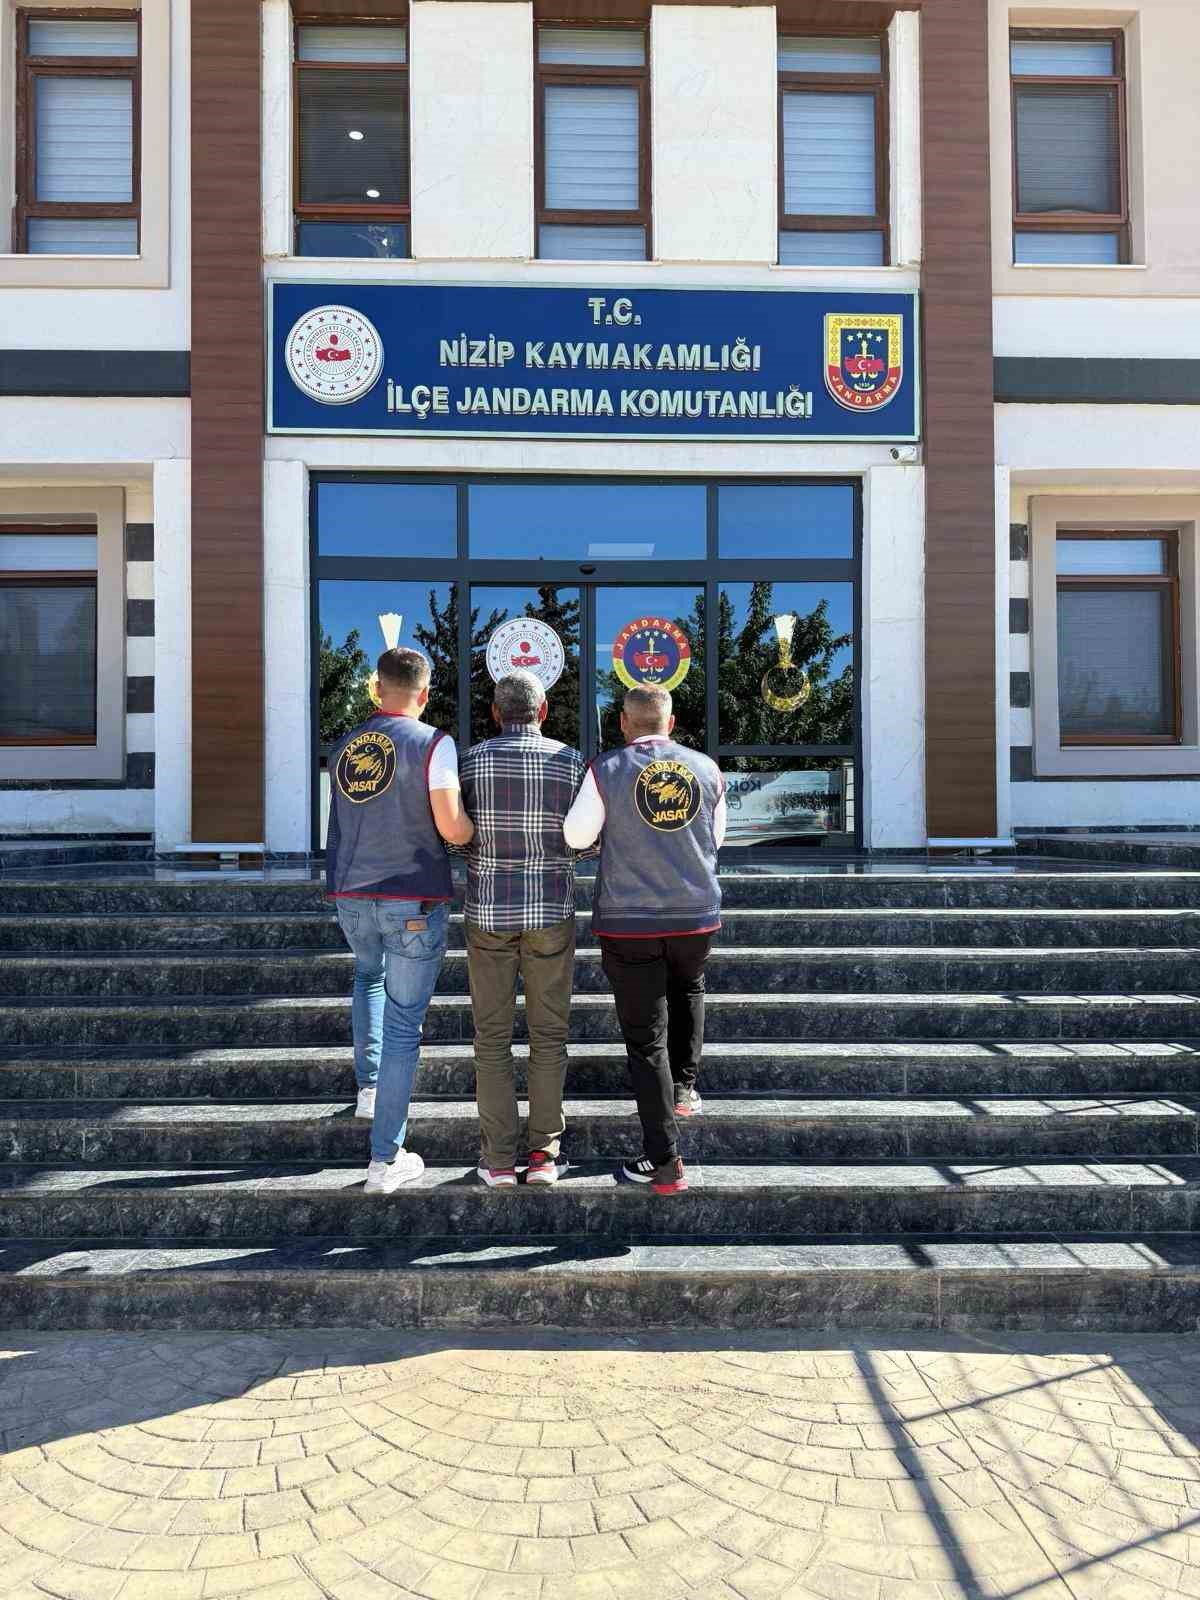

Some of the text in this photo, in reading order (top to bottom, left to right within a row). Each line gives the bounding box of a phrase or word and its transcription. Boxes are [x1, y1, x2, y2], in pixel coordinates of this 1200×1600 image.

[588, 297, 642, 325] T.C.
[439, 333, 761, 371] NİZİP KAYMAKAMLIĞI
[386, 378, 813, 420] İLÇE JANDARMA KOMUTANLIĞI
[832, 376, 897, 405] JANDARMA
[616, 619, 688, 650] JANDARMA
[345, 734, 393, 758] JANDARMA
[348, 780, 379, 793] JASAT
[640, 762, 694, 786] JANDARMA
[652, 808, 689, 823] JASAT
